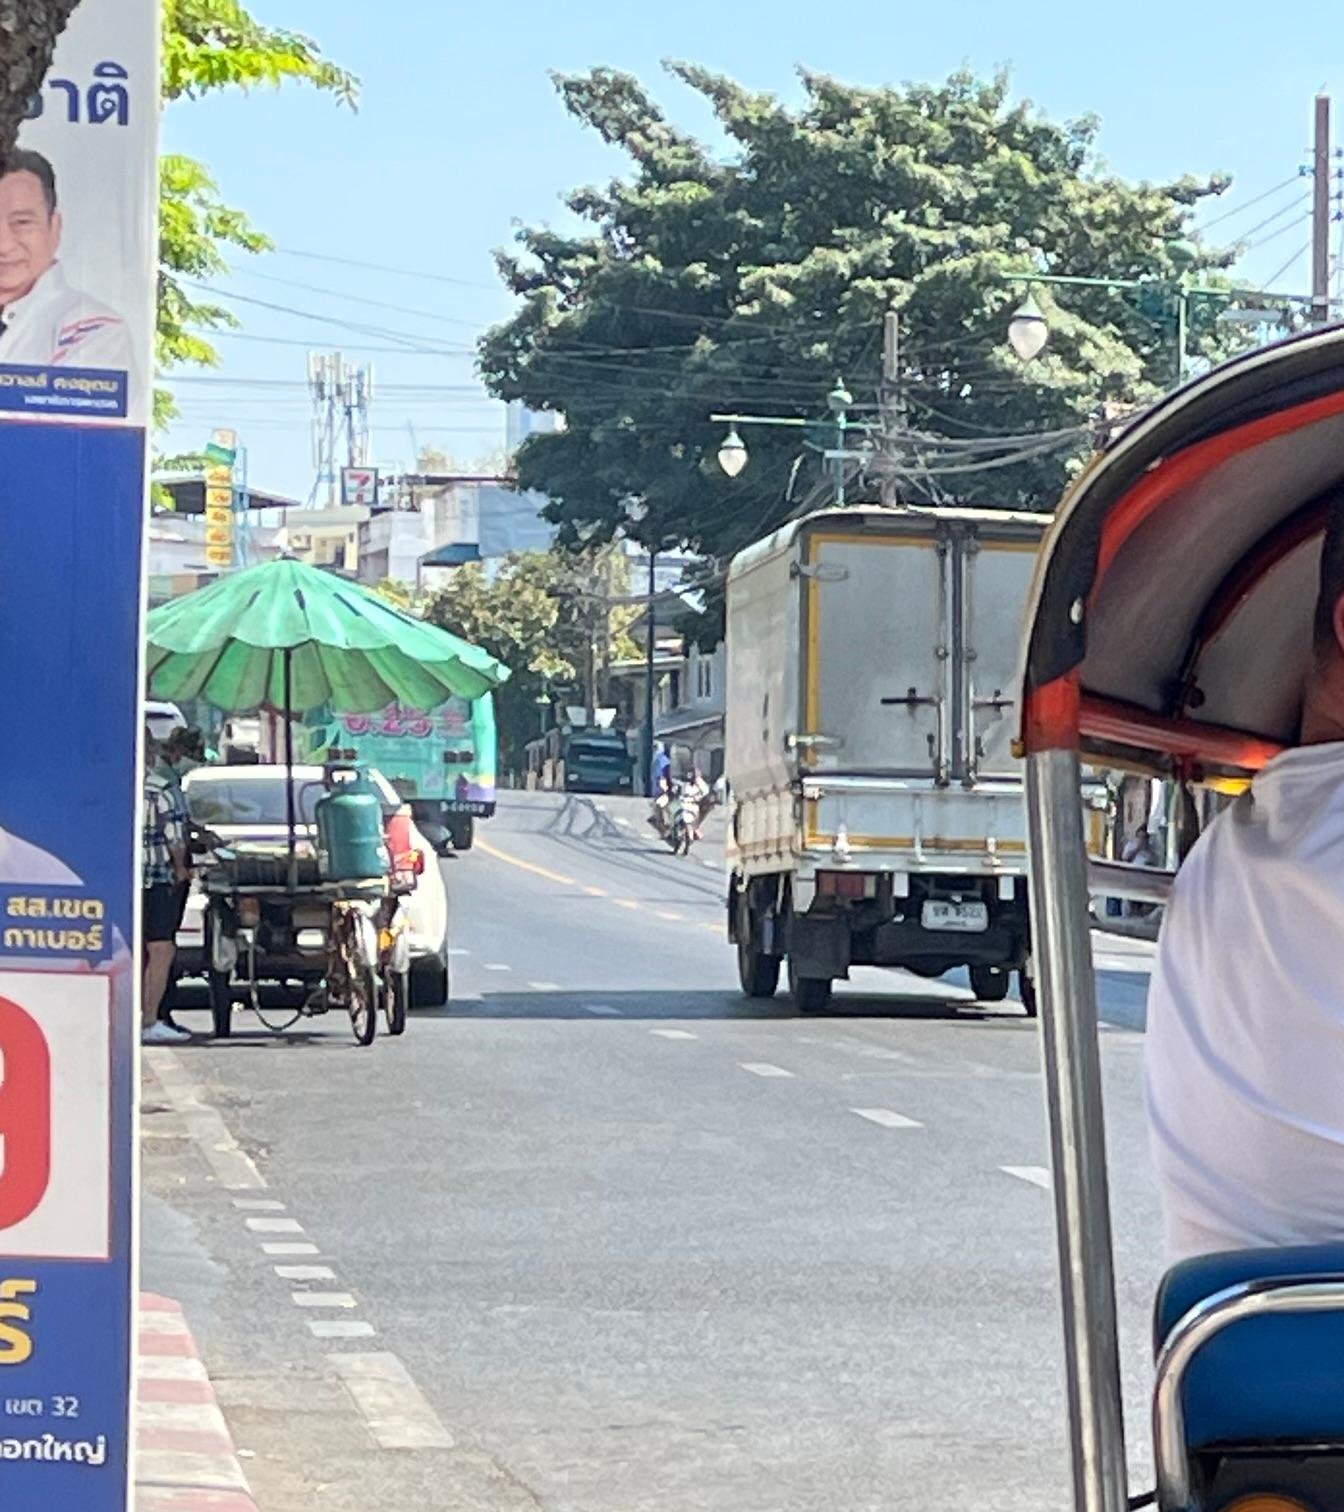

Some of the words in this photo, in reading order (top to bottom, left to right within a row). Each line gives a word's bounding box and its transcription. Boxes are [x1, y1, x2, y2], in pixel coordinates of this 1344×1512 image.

[4, 924, 104, 951] กาเบอร์
[51, 1396, 80, 1418] 32
[0, 1433, 106, 1465] อกใหญ่
